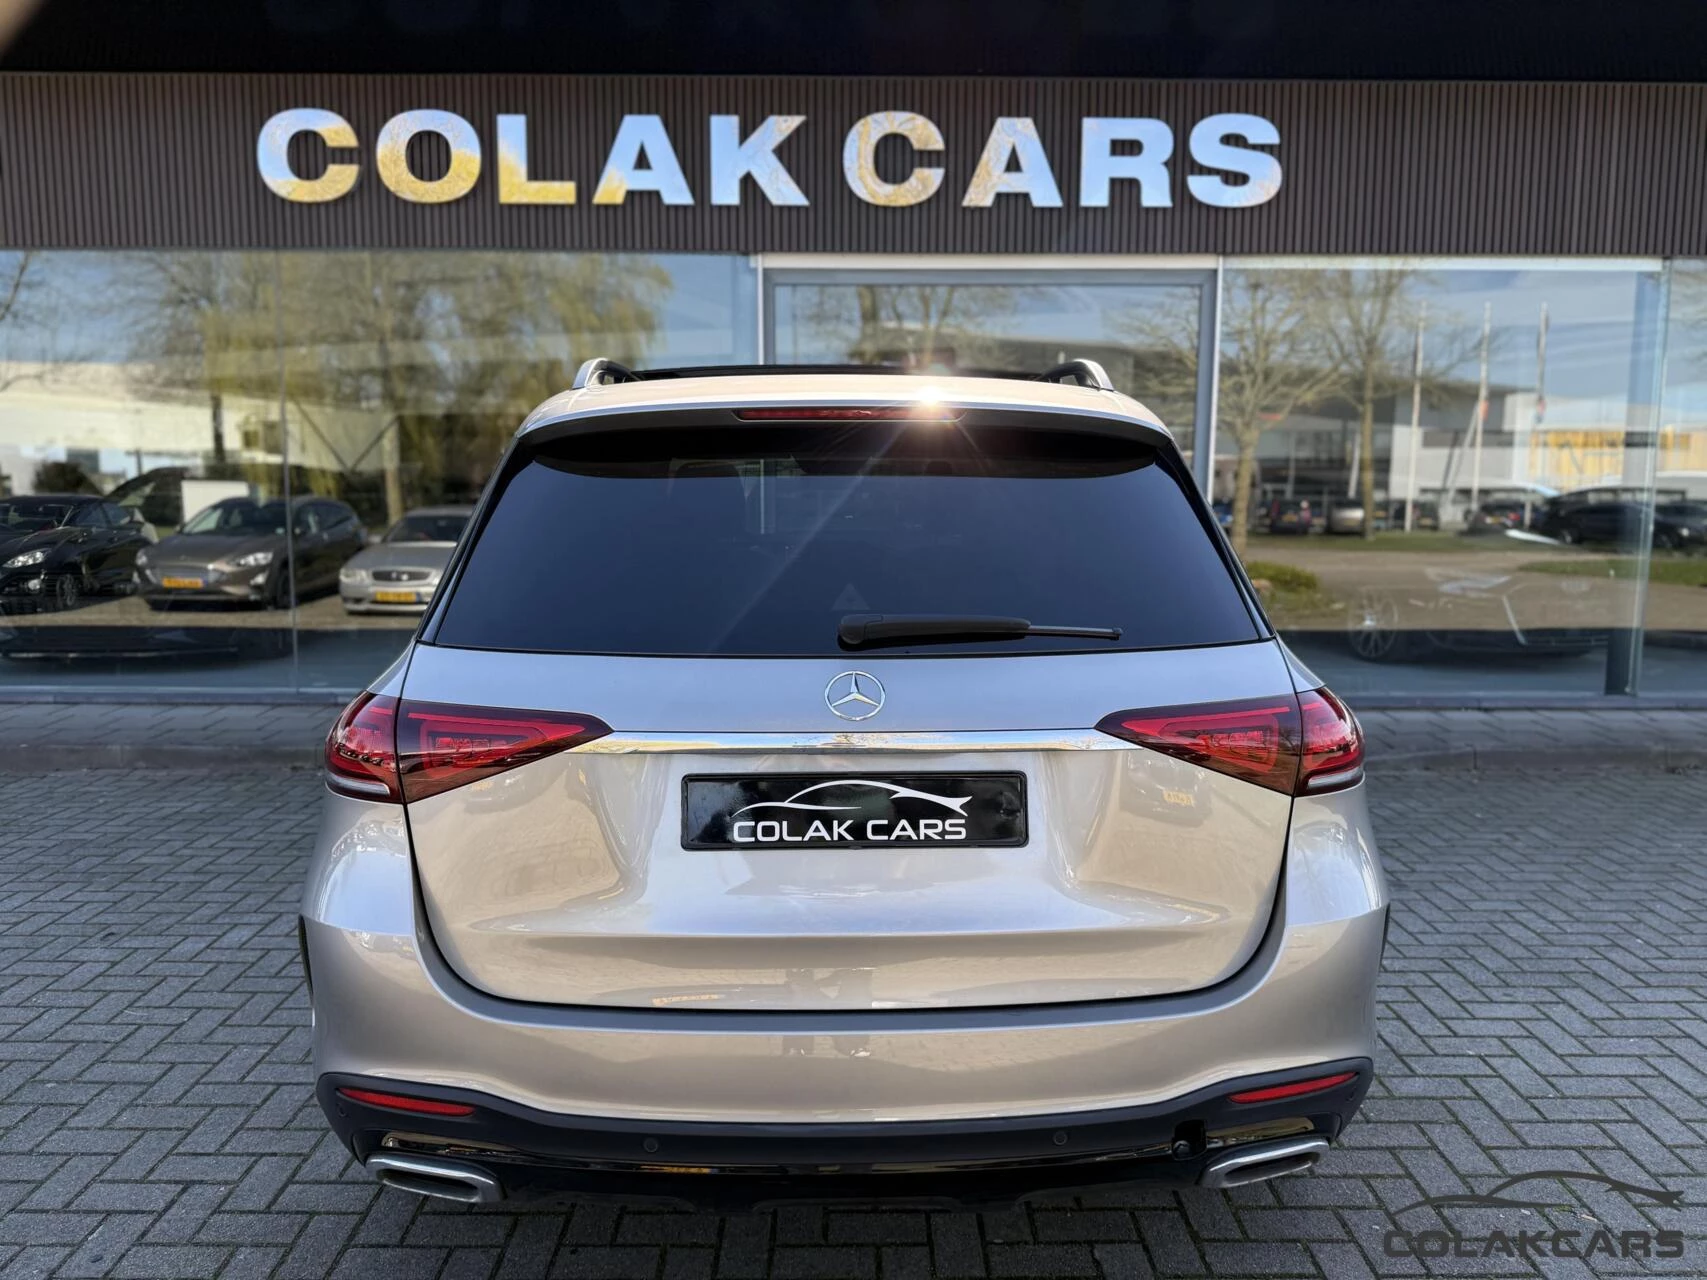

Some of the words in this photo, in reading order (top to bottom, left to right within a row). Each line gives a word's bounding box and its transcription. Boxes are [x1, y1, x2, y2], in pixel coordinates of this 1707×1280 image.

[257, 107, 810, 206] COLAK
[843, 110, 1283, 209] CARS
[732, 820, 855, 842] COLAK
[866, 819, 967, 841] CARS
